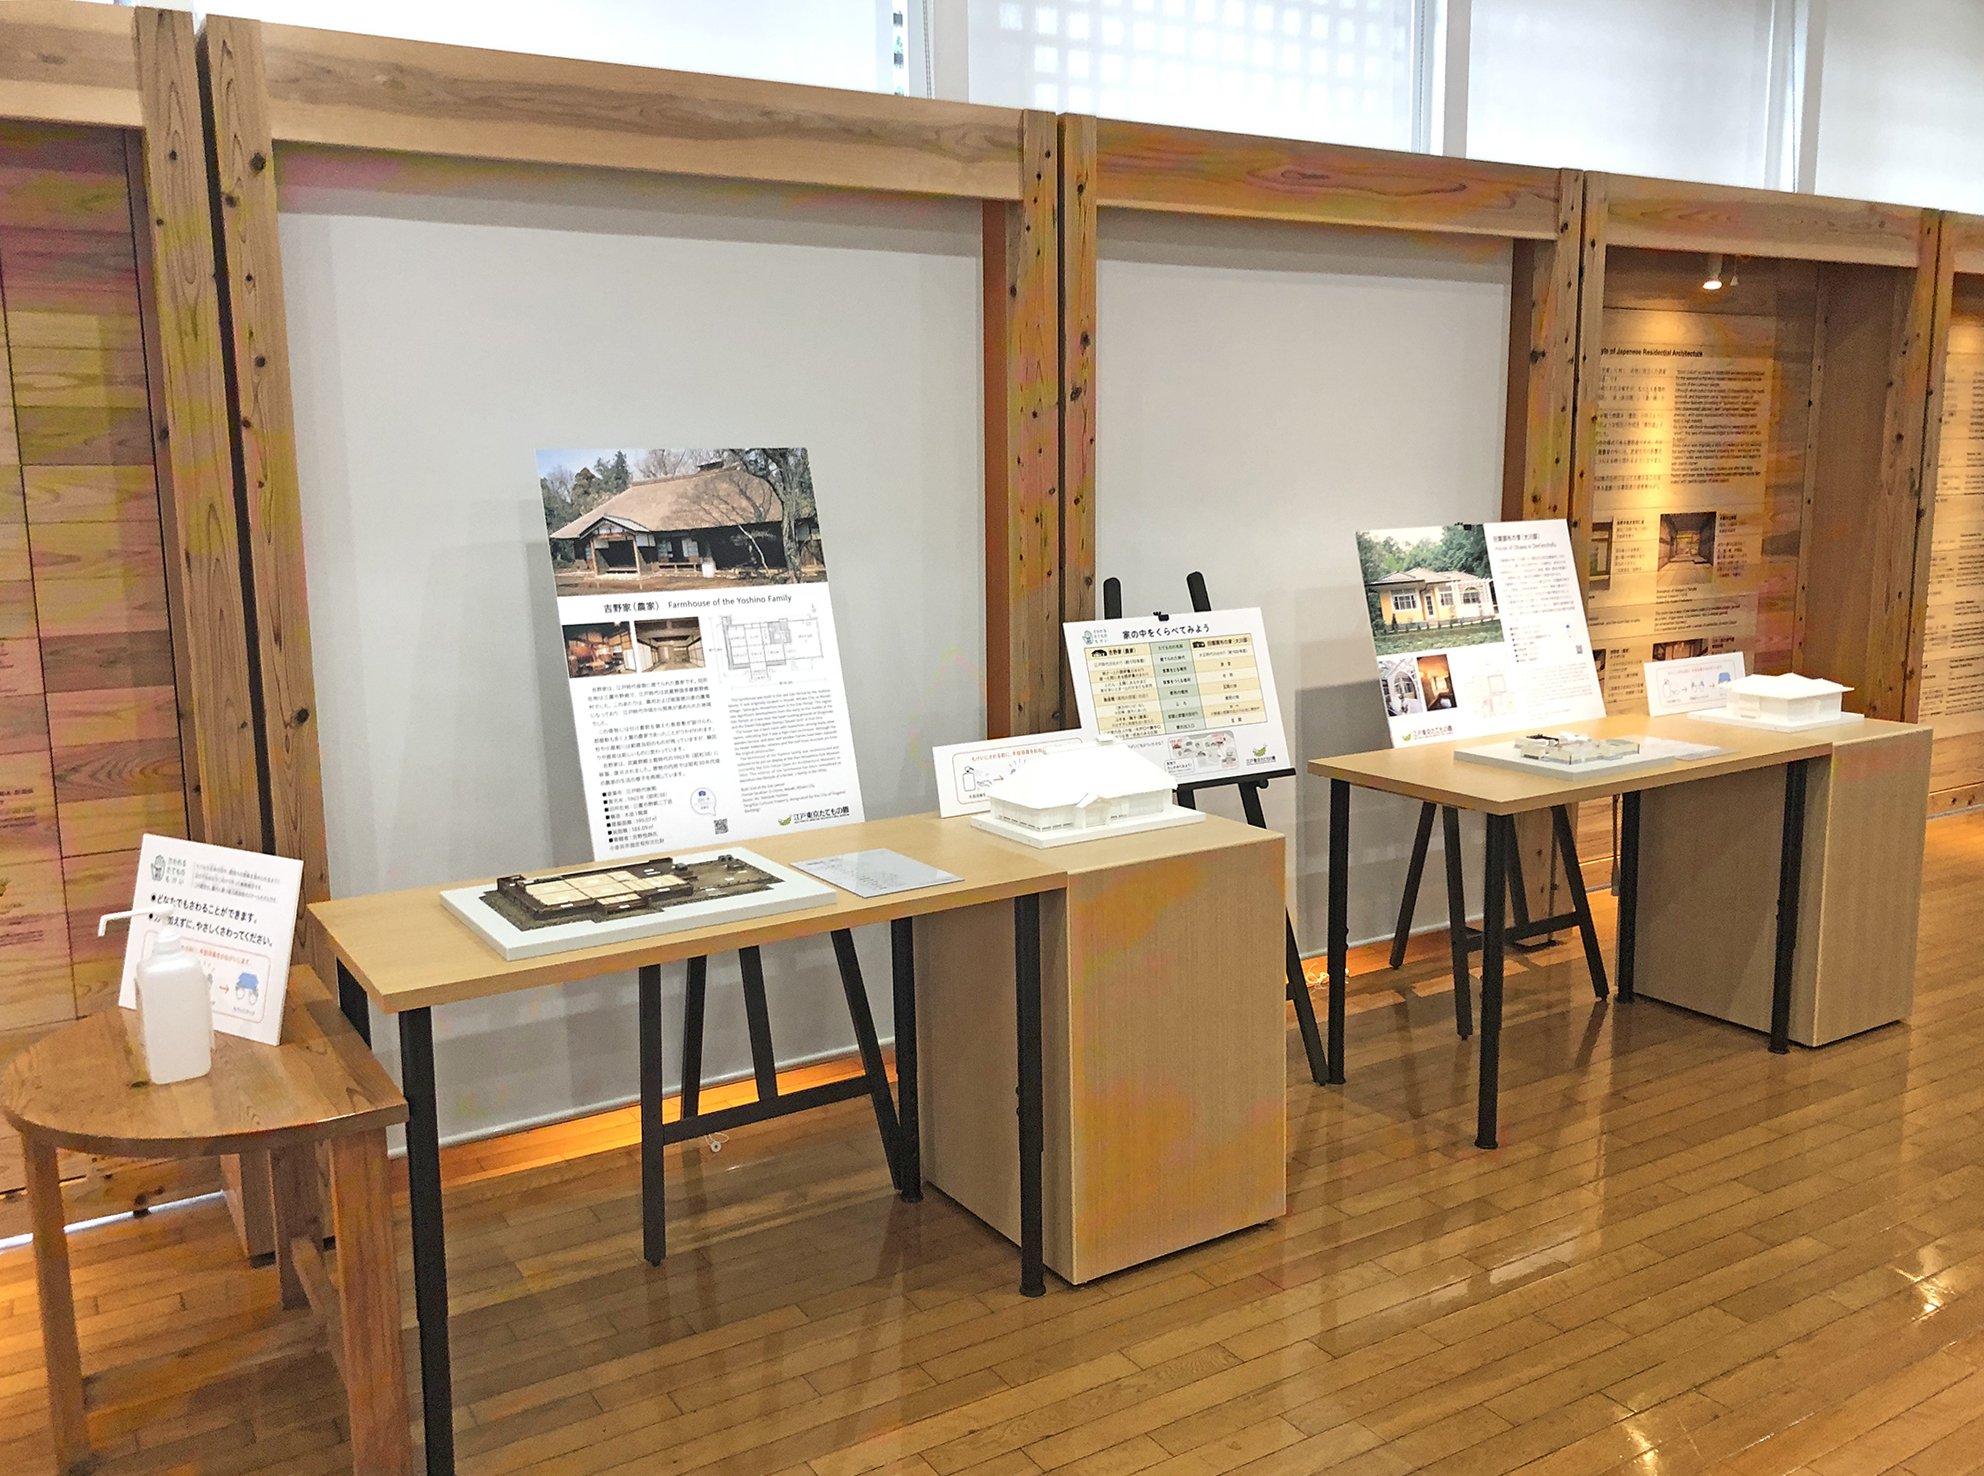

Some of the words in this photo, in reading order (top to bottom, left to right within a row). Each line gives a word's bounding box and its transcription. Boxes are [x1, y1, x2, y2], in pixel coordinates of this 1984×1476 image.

[1616, 348, 1641, 356] Japanese
[1672, 349, 1703, 357] Architecture
[604, 602, 660, 613] 吉野家（農家）
[668, 600, 711, 609] Farmhouse
[713, 598, 721, 606] of
[736, 596, 765, 604] Yoshino
[768, 594, 792, 603] Family
[1122, 624, 1210, 640] 家の中をくらべてみよう
[157, 894, 258, 924] どなたでもさわることができます。
